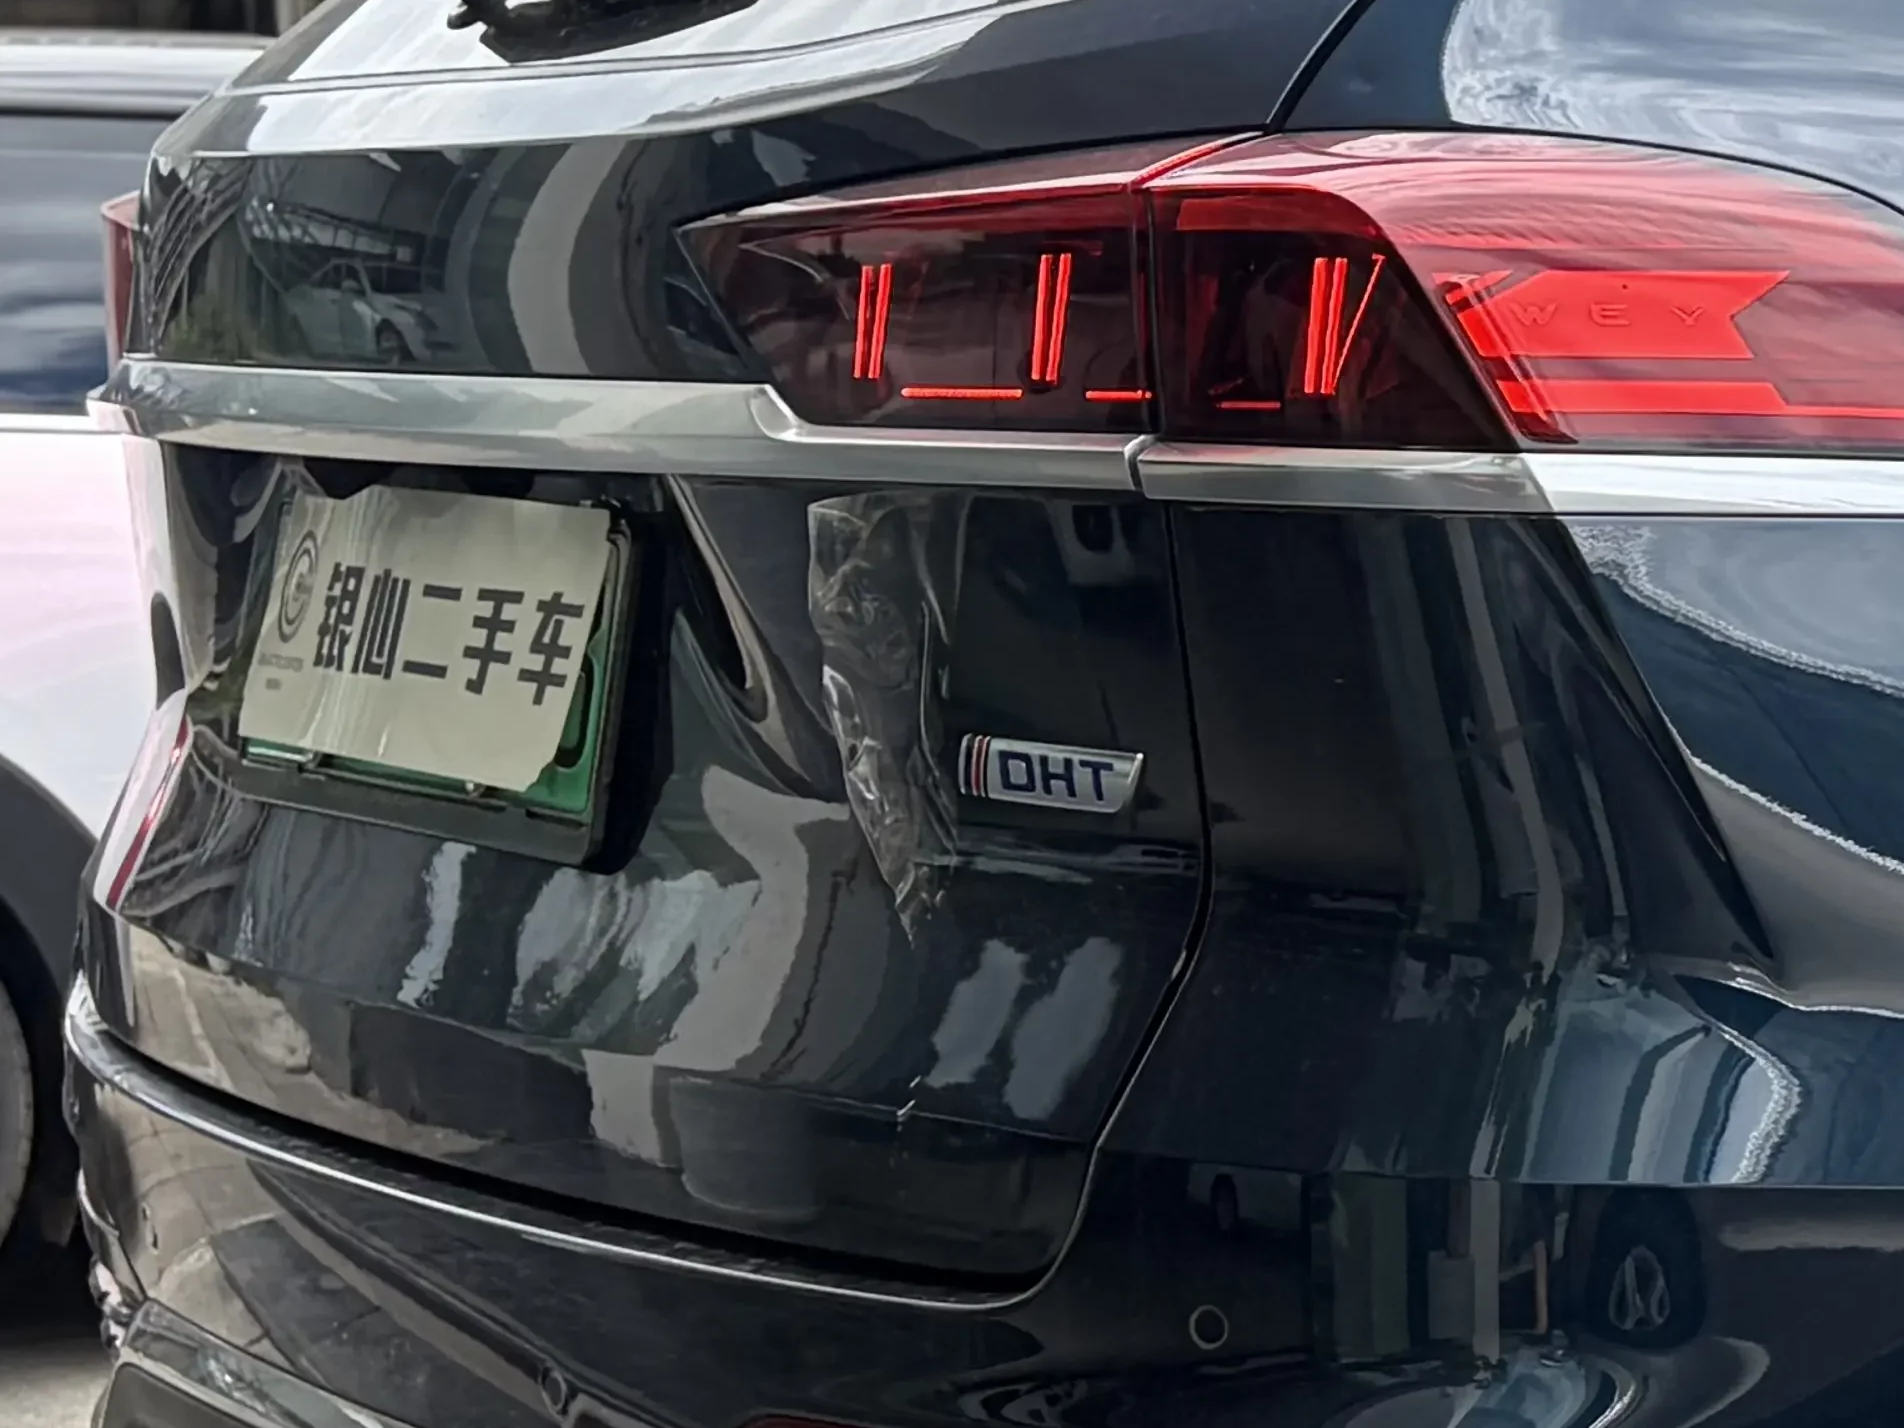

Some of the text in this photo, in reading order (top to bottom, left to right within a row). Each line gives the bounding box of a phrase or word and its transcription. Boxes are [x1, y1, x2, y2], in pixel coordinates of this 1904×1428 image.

[1508, 301, 1706, 328] WEY
[313, 562, 585, 707] 银心二手车
[998, 750, 1114, 801] DHT
